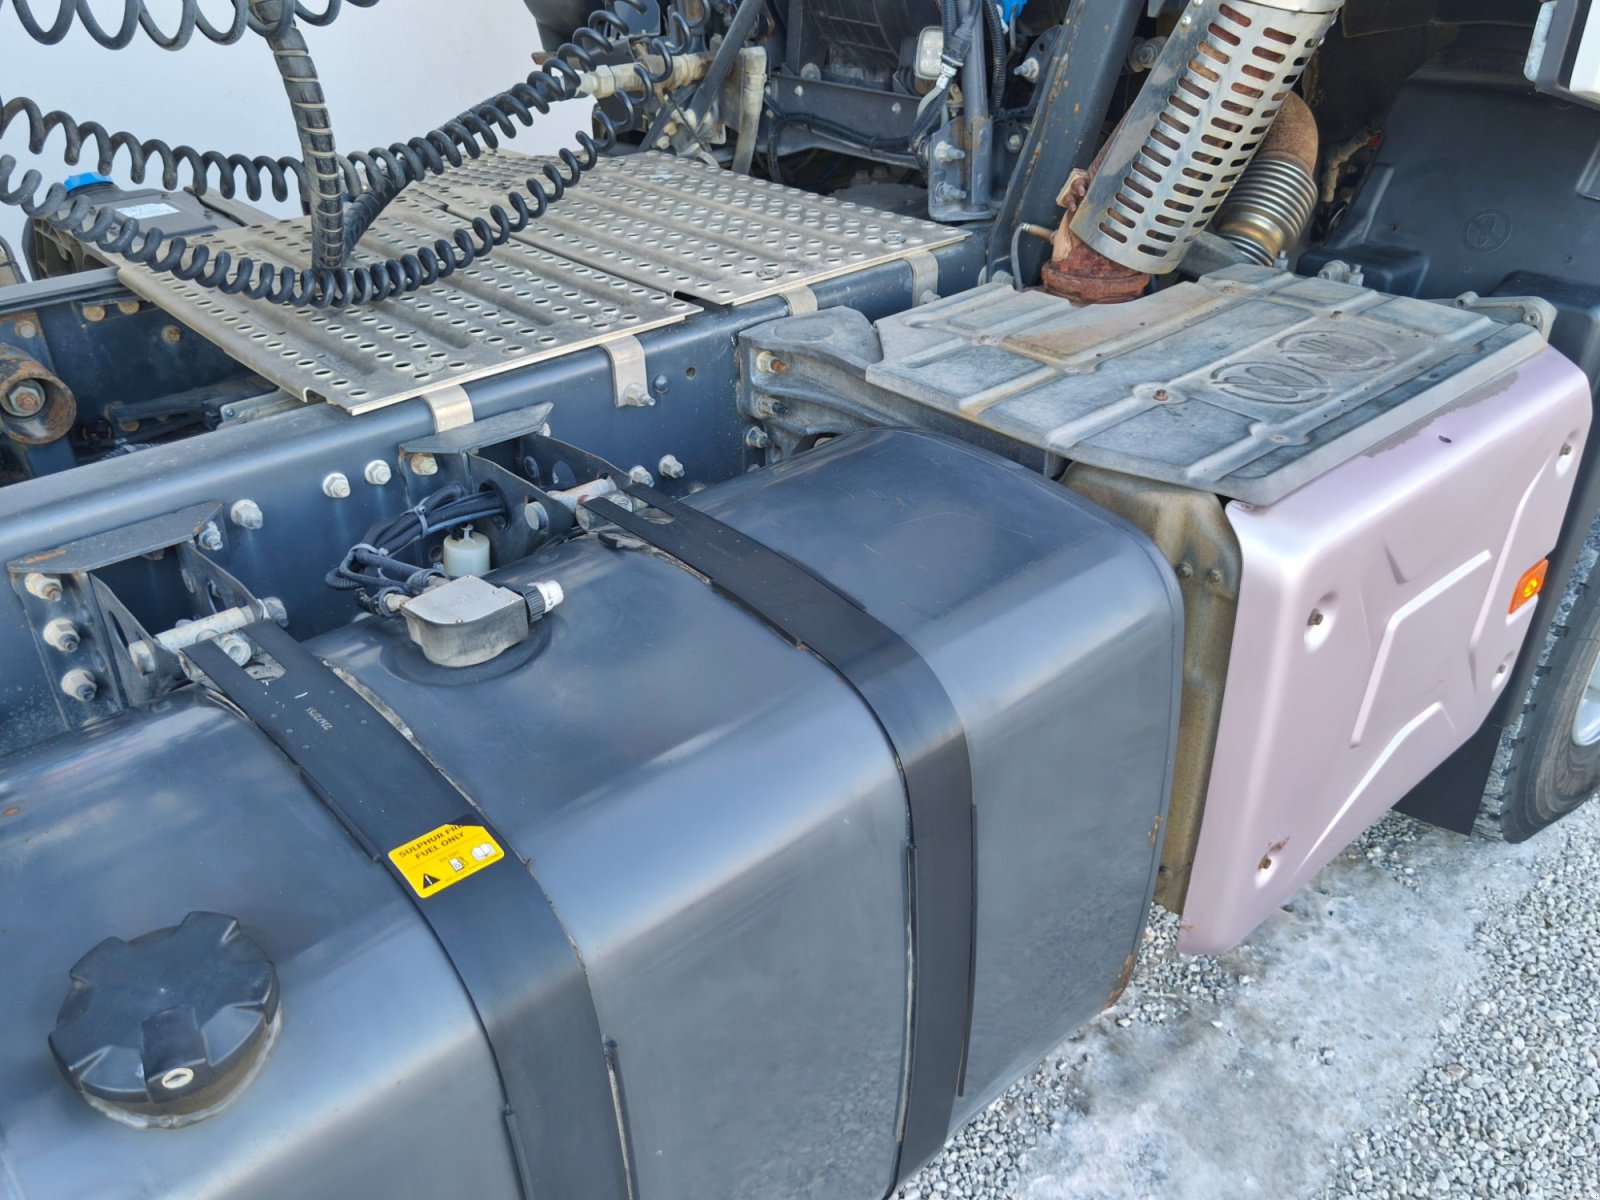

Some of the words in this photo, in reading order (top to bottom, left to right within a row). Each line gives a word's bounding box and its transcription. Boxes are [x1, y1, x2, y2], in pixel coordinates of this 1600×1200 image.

[399, 832, 444, 857] SULPHUR
[415, 845, 439, 859] FUEL
[441, 832, 464, 847] ONLY
